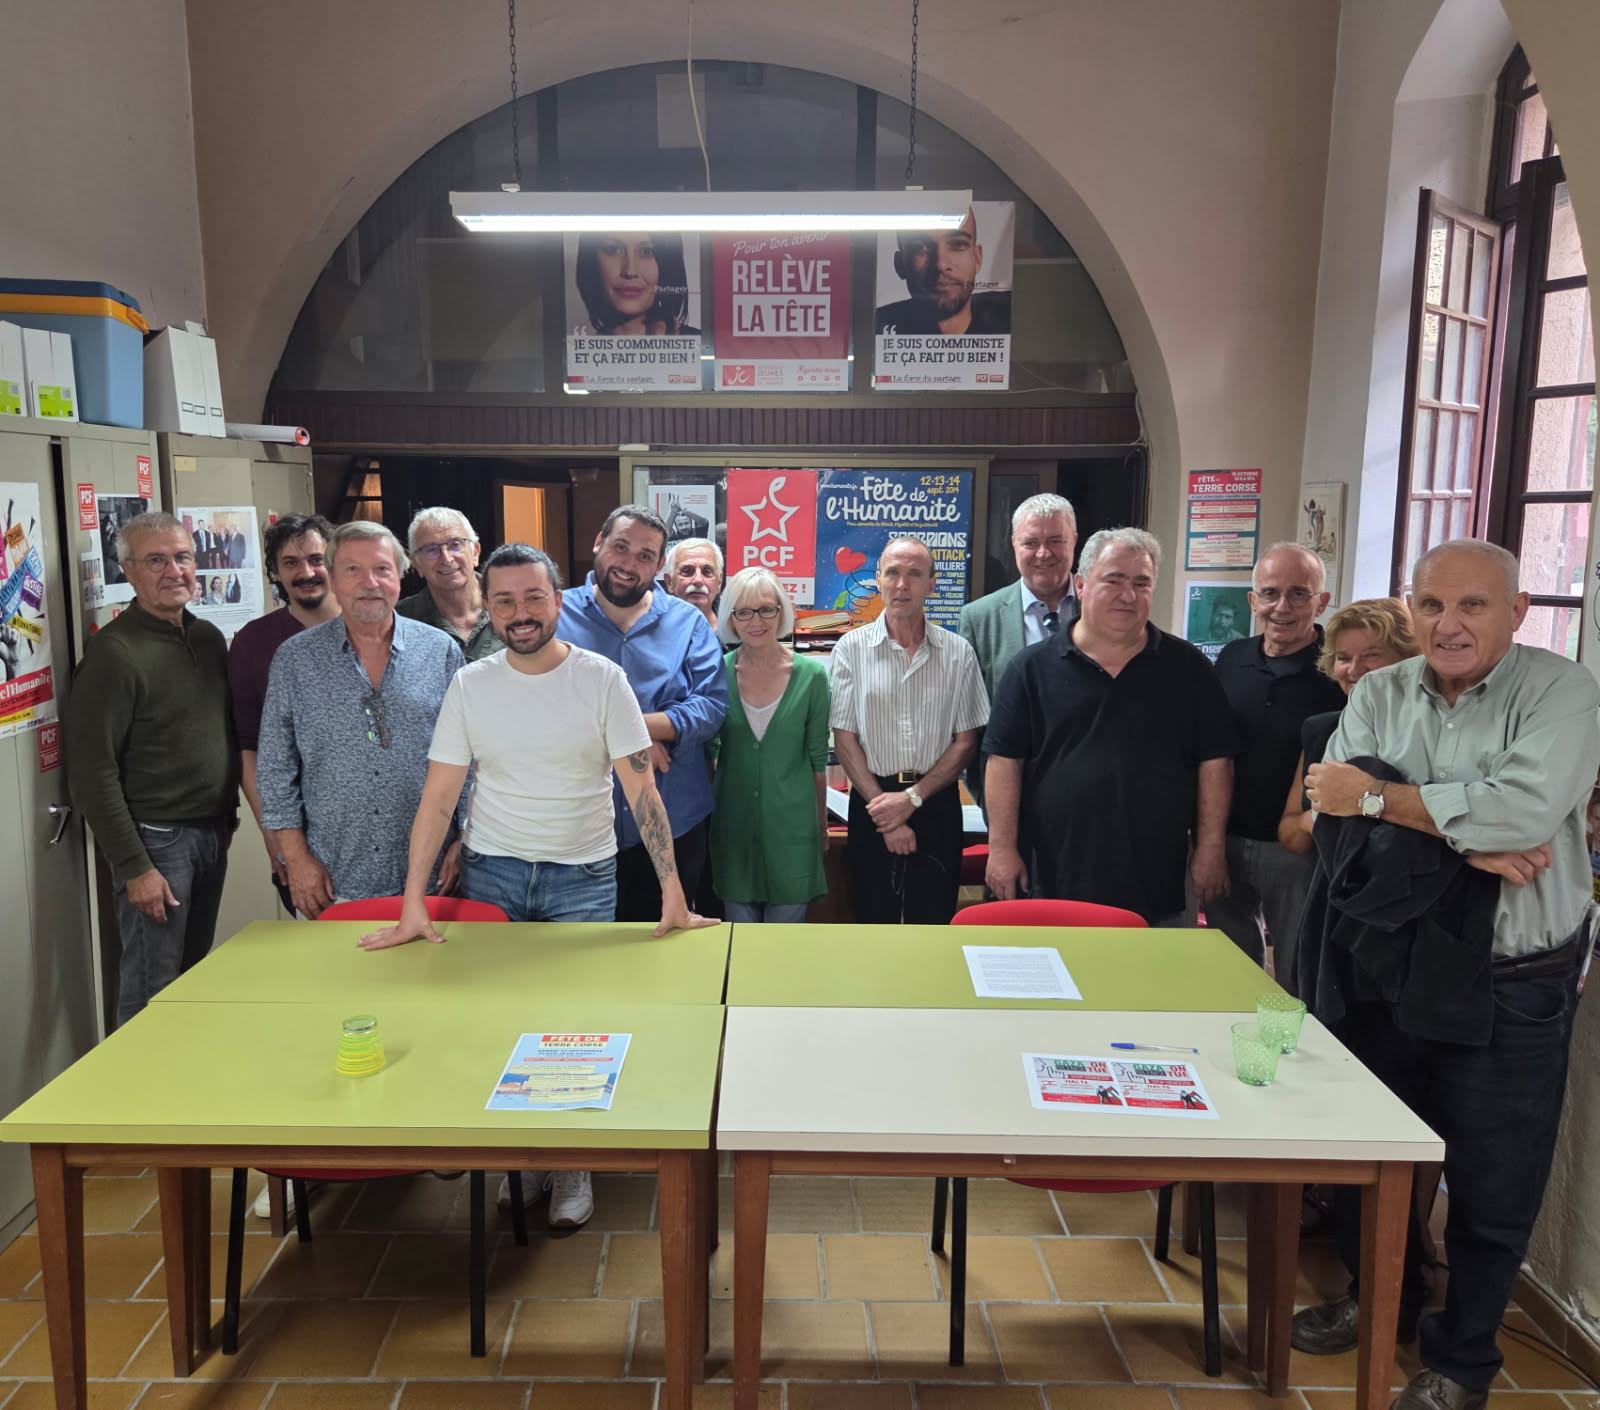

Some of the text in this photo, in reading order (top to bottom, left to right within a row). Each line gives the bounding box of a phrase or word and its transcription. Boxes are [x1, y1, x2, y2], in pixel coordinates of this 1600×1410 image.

[733, 240, 767, 256] Pour
[769, 236, 789, 250] ton
[732, 253, 831, 293] RELÈVE
[737, 299, 826, 332] LA TÊTE
[574, 339, 696, 350] JE SUIS COMMUNISTE
[883, 338, 1005, 350] JE SUIS COMMUNISTE
[575, 353, 589, 364] ET
[592, 353, 609, 367] ÇA
[612, 353, 637, 364] FAIT
[640, 353, 656, 364] DU
[659, 353, 688, 364] BIEN
[883, 352, 898, 363] ET
[901, 352, 917, 366] ÇA
[920, 352, 945, 363] FAIT
[947, 352, 965, 363] DU
[967, 352, 997, 363] BIEN
[1198, 475, 1216, 484] FÊTE
[860, 476, 928, 503] Fête de
[1192, 483, 1258, 493] TERRE CORSE
[826, 496, 961, 522] l'Humanité
[743, 545, 795, 568] PCF
[934, 562, 966, 571] VILLIERS
[782, 583, 797, 593] EZ
[41, 728, 57, 745] PCF
